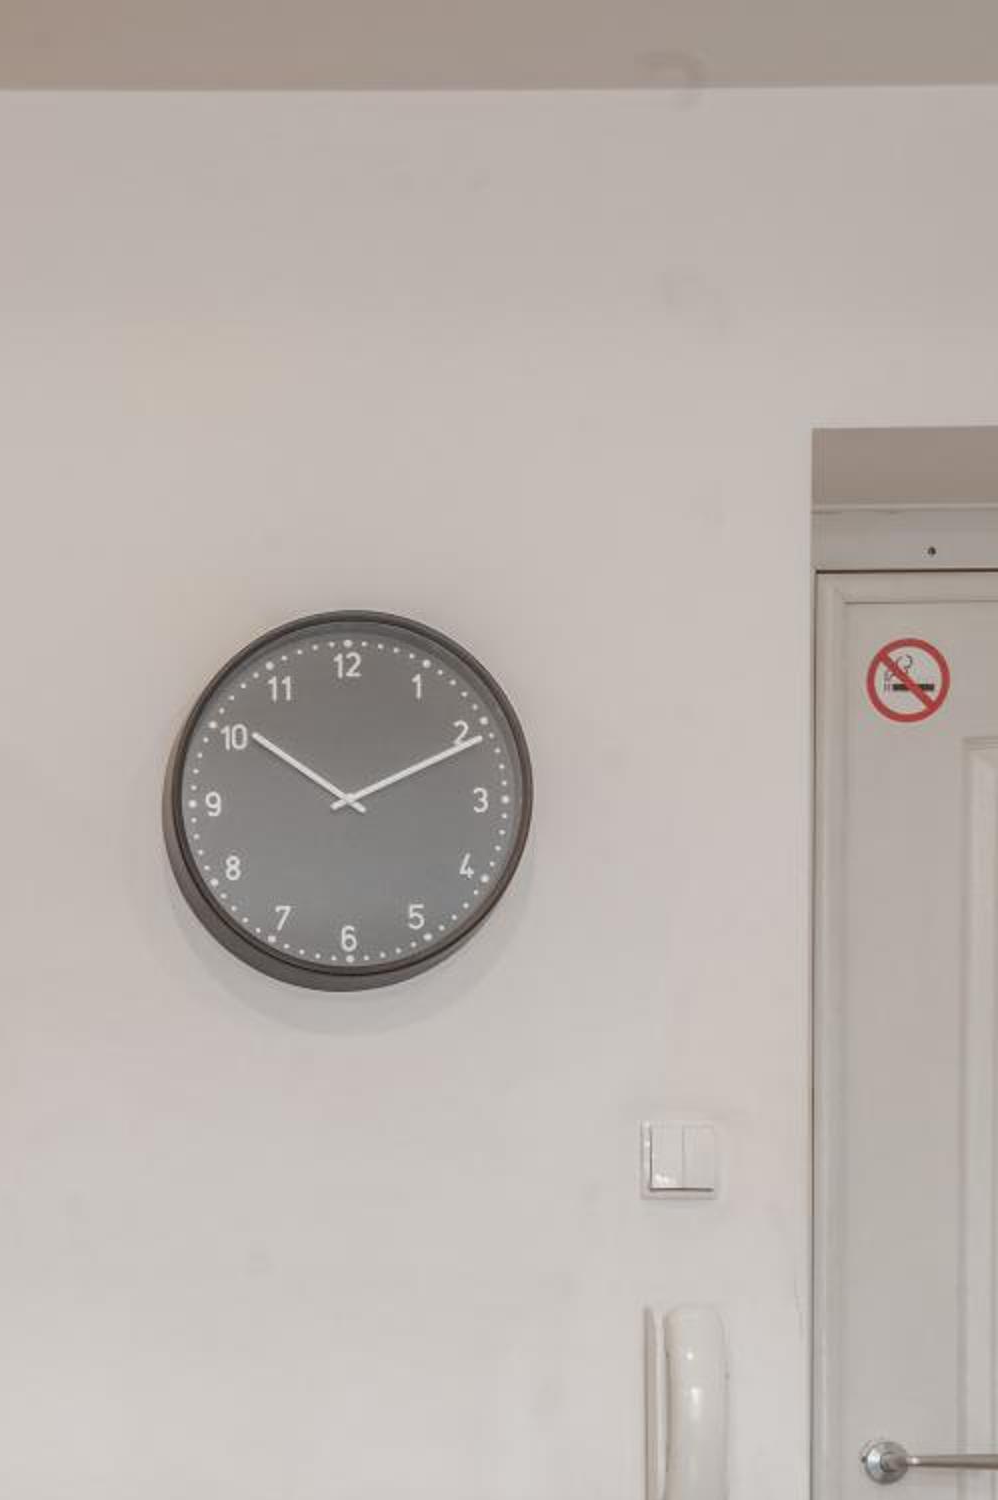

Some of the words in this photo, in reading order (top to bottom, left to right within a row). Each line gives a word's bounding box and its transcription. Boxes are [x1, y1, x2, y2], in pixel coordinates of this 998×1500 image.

[333, 651, 362, 679] 12
[267, 675, 292, 702] 11
[411, 673, 422, 700] 1
[220, 723, 248, 751] 10
[452, 720, 470, 746] 2
[204, 791, 222, 817] 9
[472, 787, 489, 813] 3
[225, 855, 242, 881] 8
[458, 853, 475, 879] 4
[274, 904, 292, 931] 7
[408, 903, 426, 930] 5
[340, 924, 358, 952] 6
